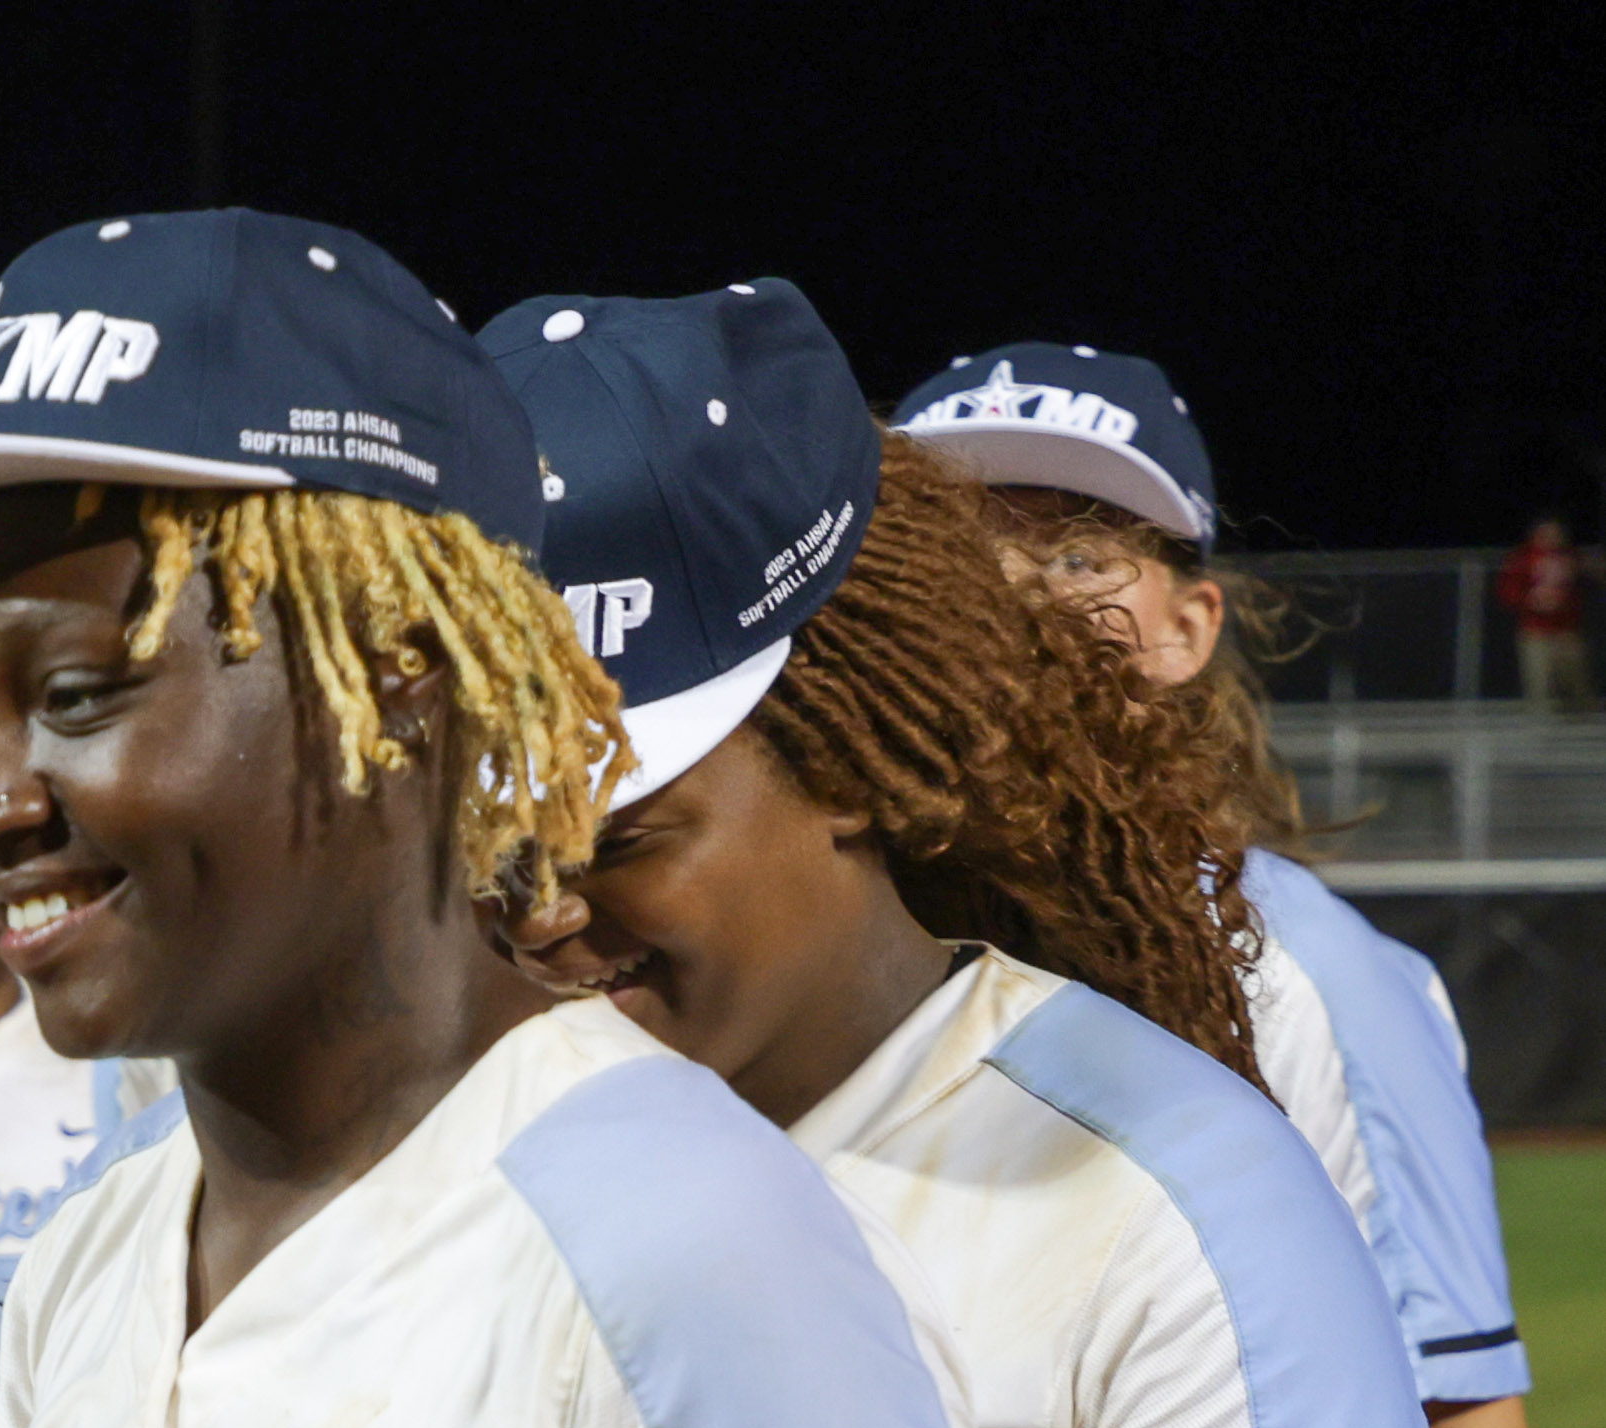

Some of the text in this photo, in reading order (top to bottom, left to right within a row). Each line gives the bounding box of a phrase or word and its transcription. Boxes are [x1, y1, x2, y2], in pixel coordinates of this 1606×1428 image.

[289, 408, 402, 446] 2023 AHSAA
[239, 428, 439, 487] SOFTBALL CHAMPIONS
[737, 568, 808, 628] SOFTBALL
